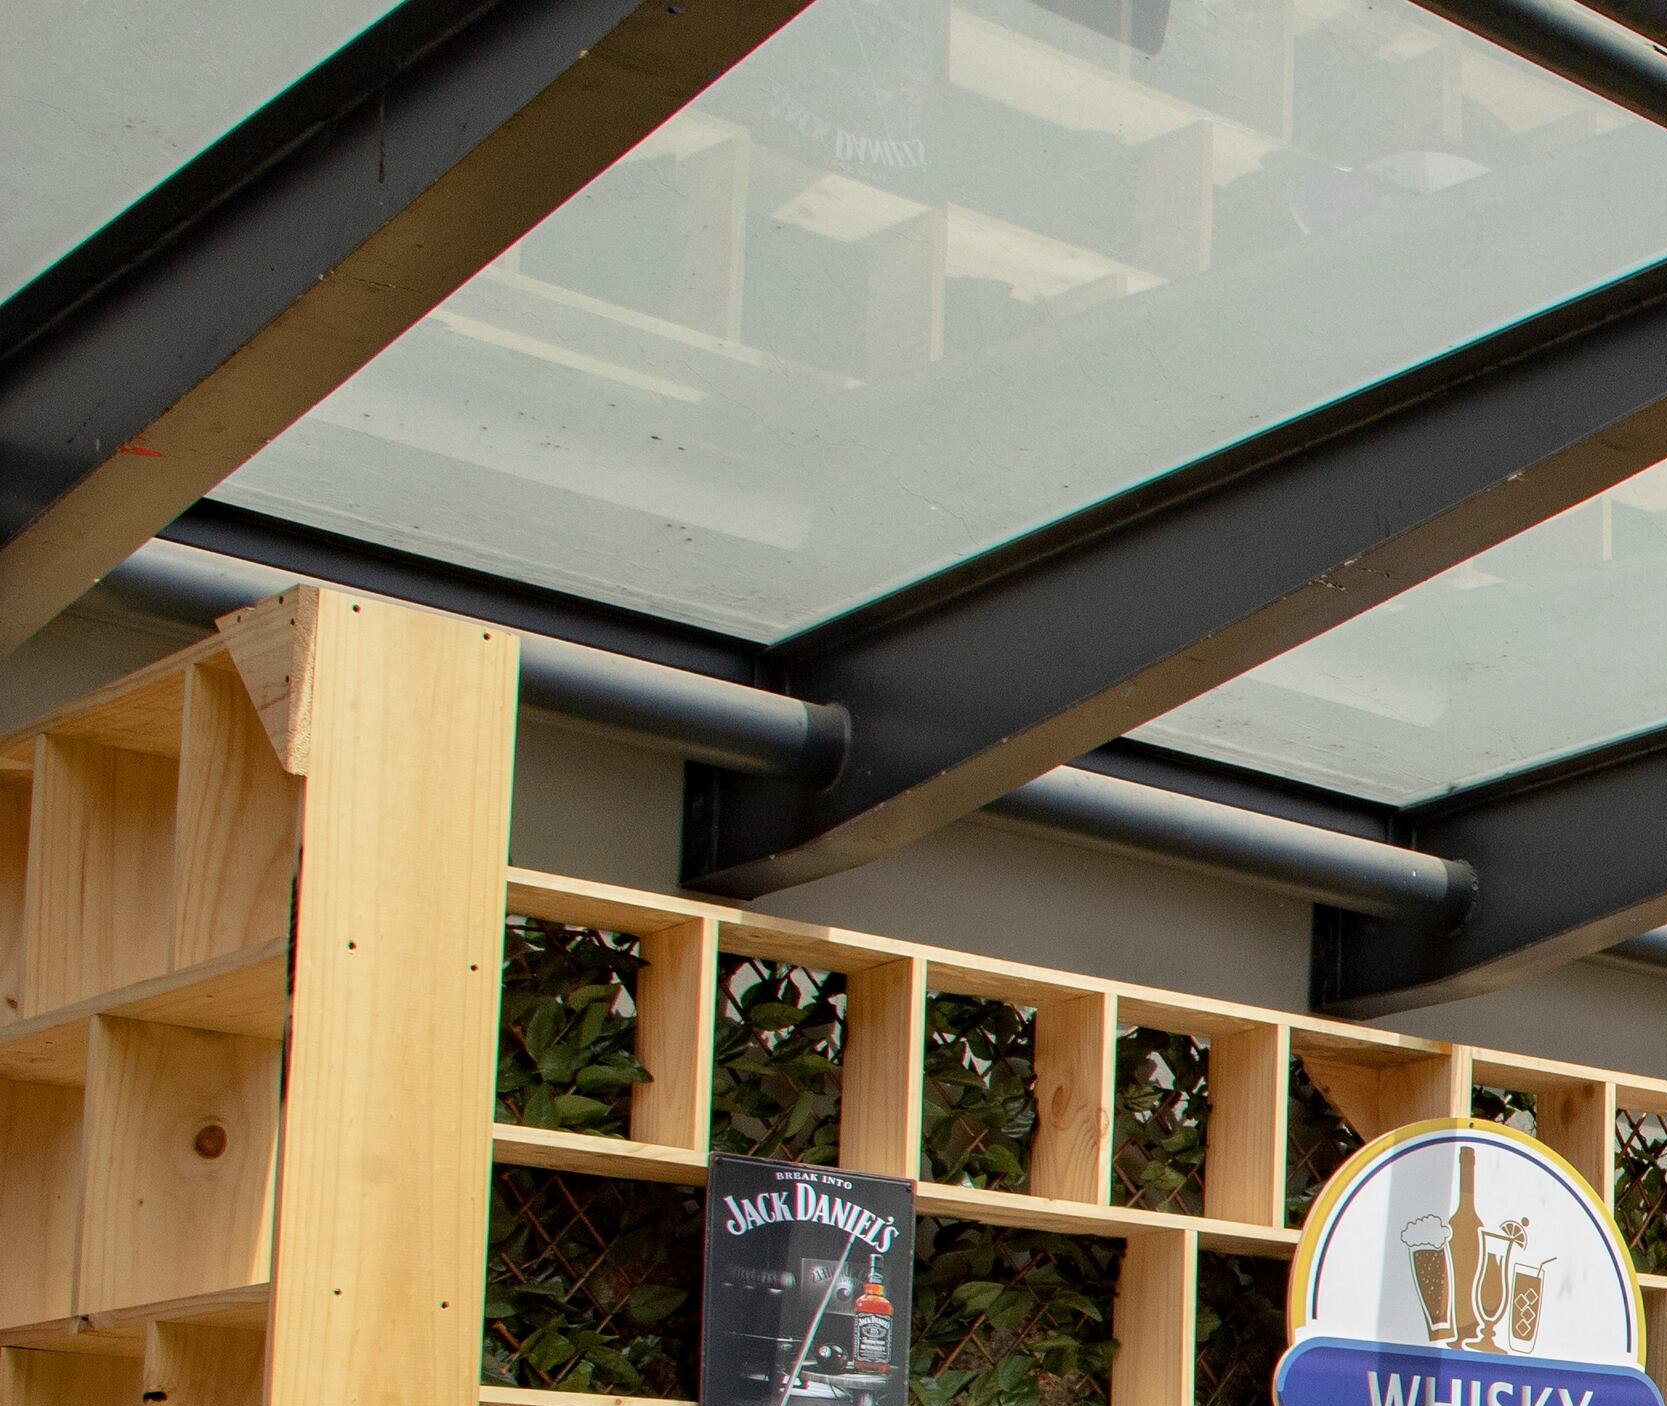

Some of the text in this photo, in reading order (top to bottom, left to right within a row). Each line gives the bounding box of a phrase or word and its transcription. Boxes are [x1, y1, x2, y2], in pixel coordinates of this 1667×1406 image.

[775, 1171, 853, 1190] BREAK INTO
[723, 1182, 900, 1253] JACK DANIEL'S
